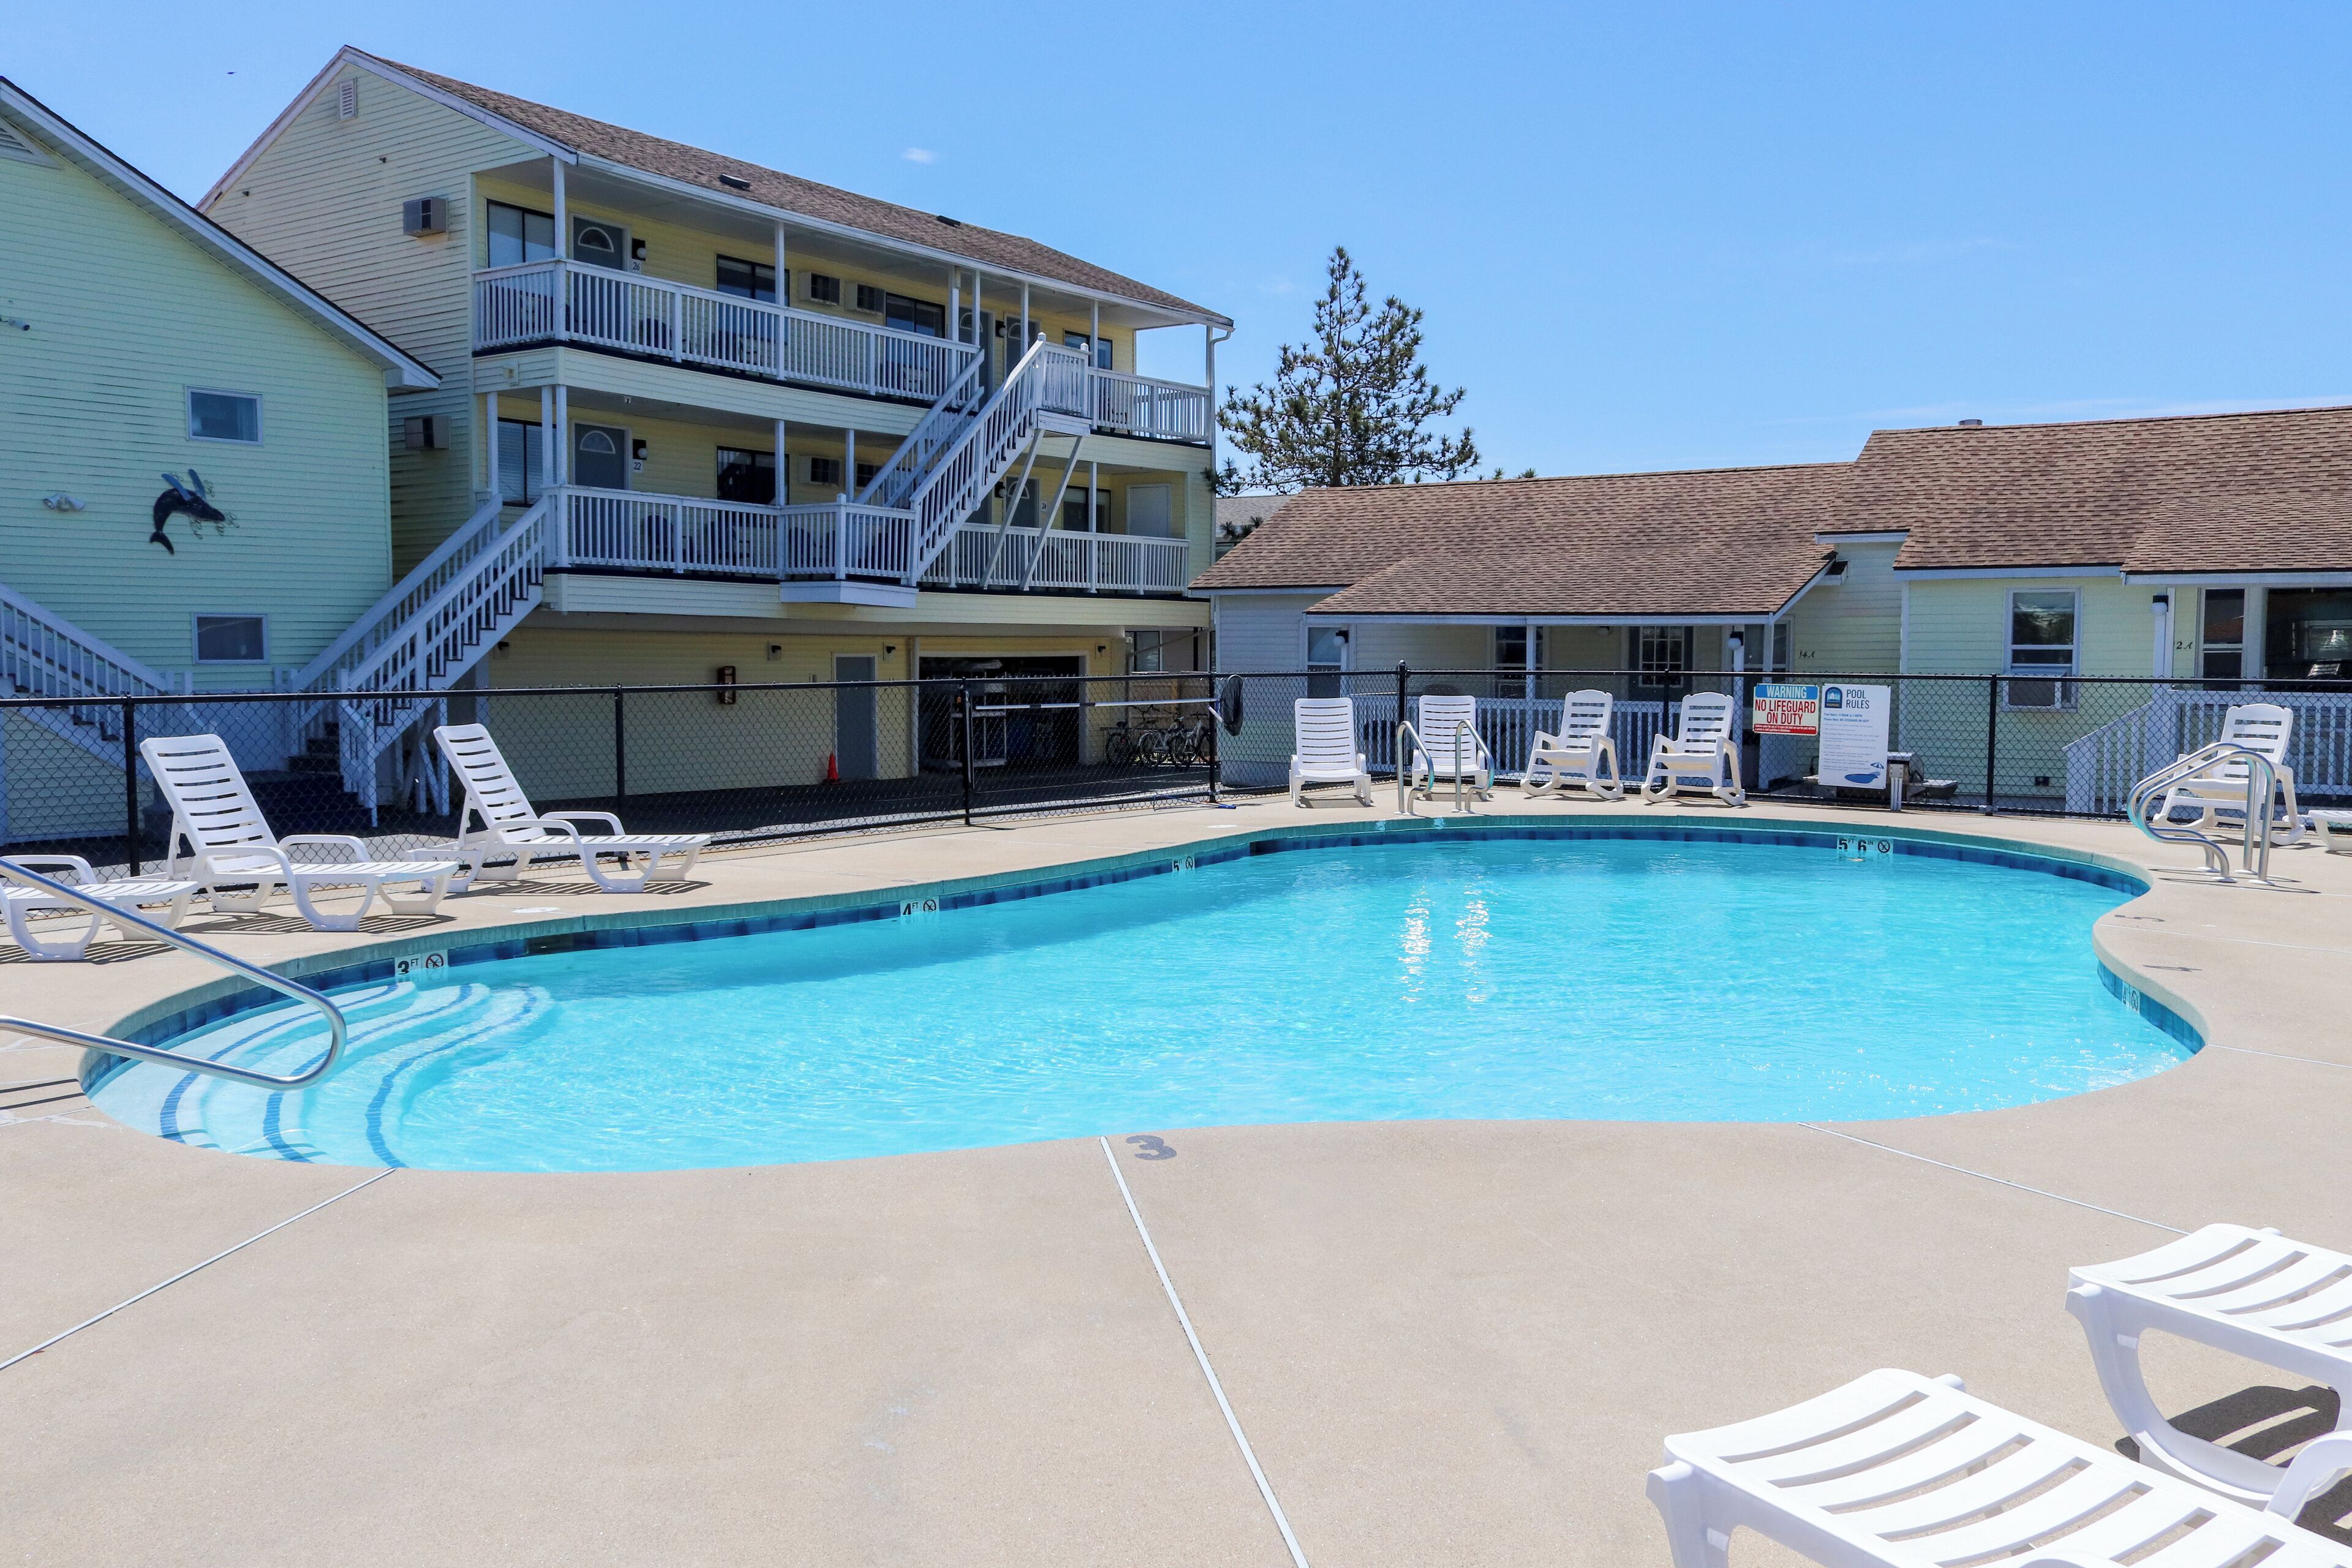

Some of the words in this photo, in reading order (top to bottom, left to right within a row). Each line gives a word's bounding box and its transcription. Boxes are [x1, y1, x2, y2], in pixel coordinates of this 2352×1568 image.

[633, 262, 640, 270] 26
[1766, 685, 1807, 698] WARNING
[1847, 689, 1866, 699] POOL
[1755, 699, 1766, 711] NO
[1769, 700, 1816, 713] LIFEGUARD
[1846, 699, 1869, 709] RULES
[1766, 712, 1778, 723] ON
[1781, 712, 1803, 725] DUTY
[1839, 838, 1848, 850] 5
[398, 960, 410, 974] 3
[410, 958, 419, 967] FT
[1126, 1135, 1177, 1161] 3
